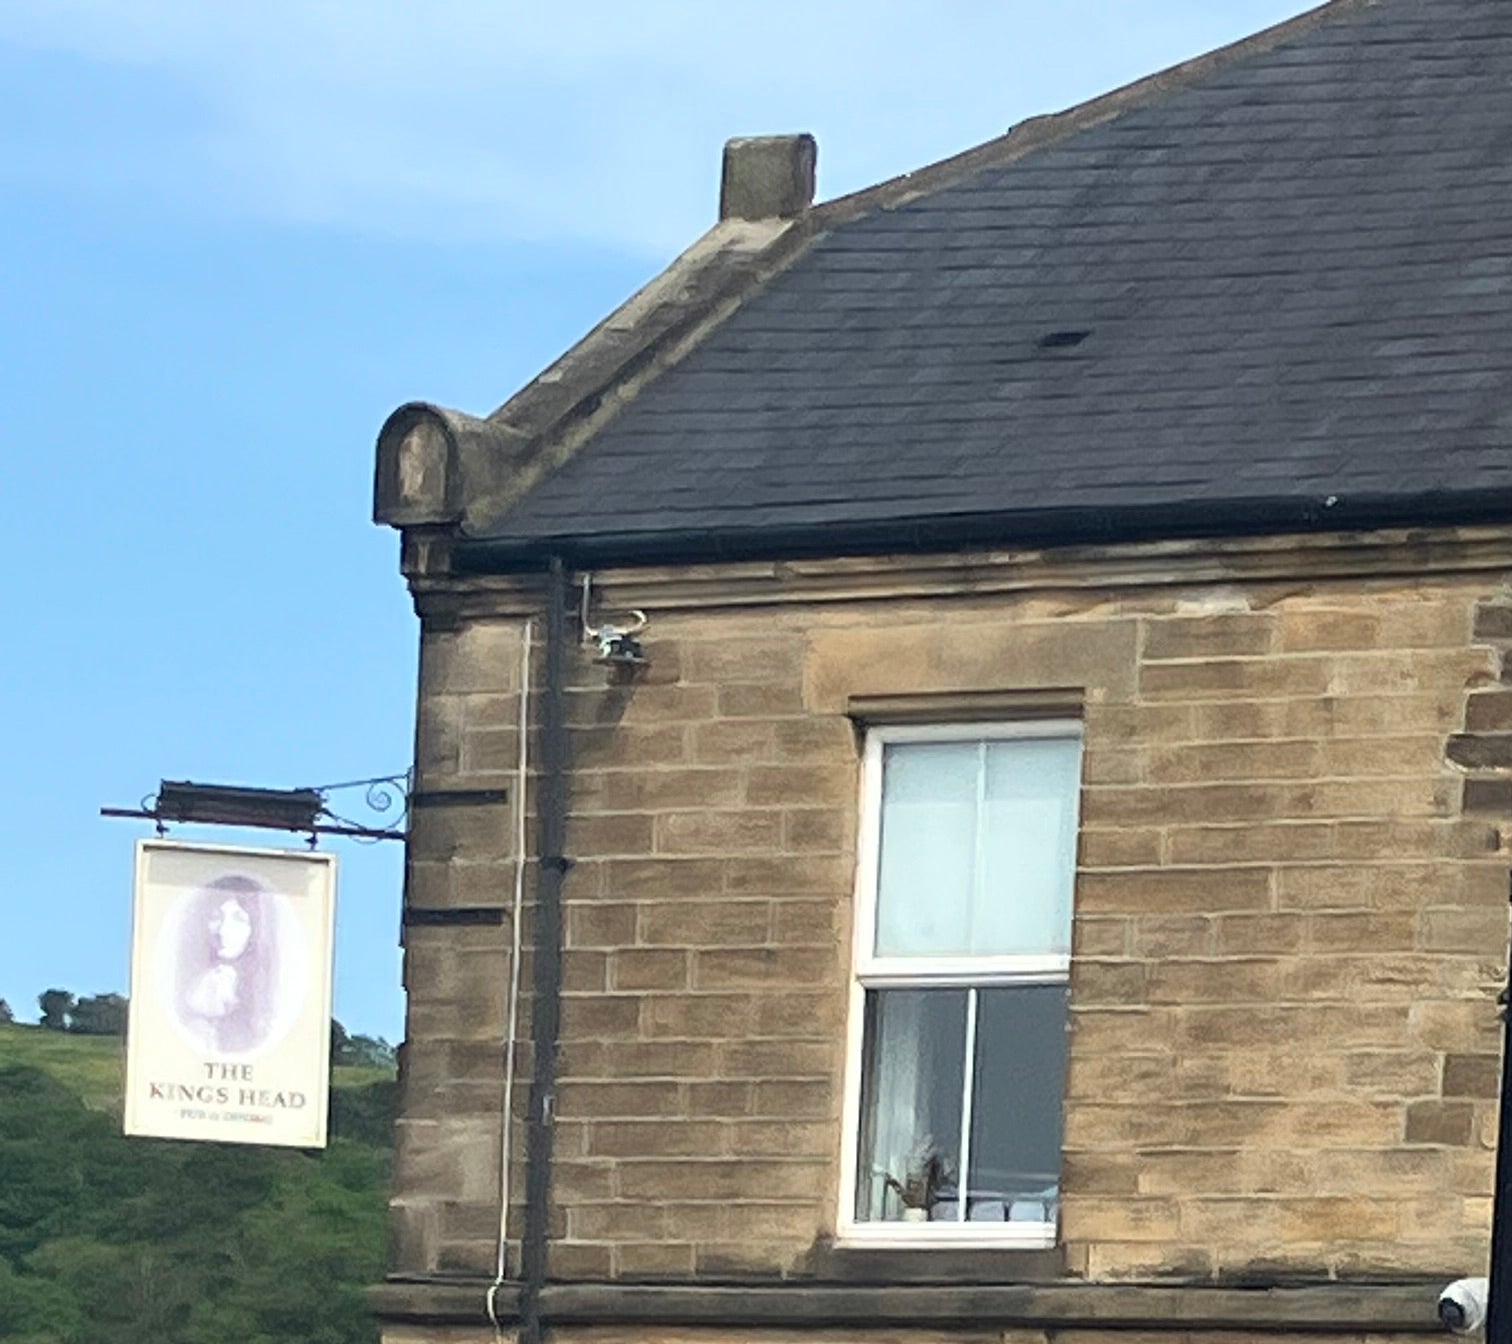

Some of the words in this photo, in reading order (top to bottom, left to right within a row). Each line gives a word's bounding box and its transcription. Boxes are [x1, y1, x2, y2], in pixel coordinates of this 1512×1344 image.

[204, 1062, 253, 1082] THE
[149, 1081, 229, 1105] KINGS
[239, 1089, 307, 1110] HEAD
